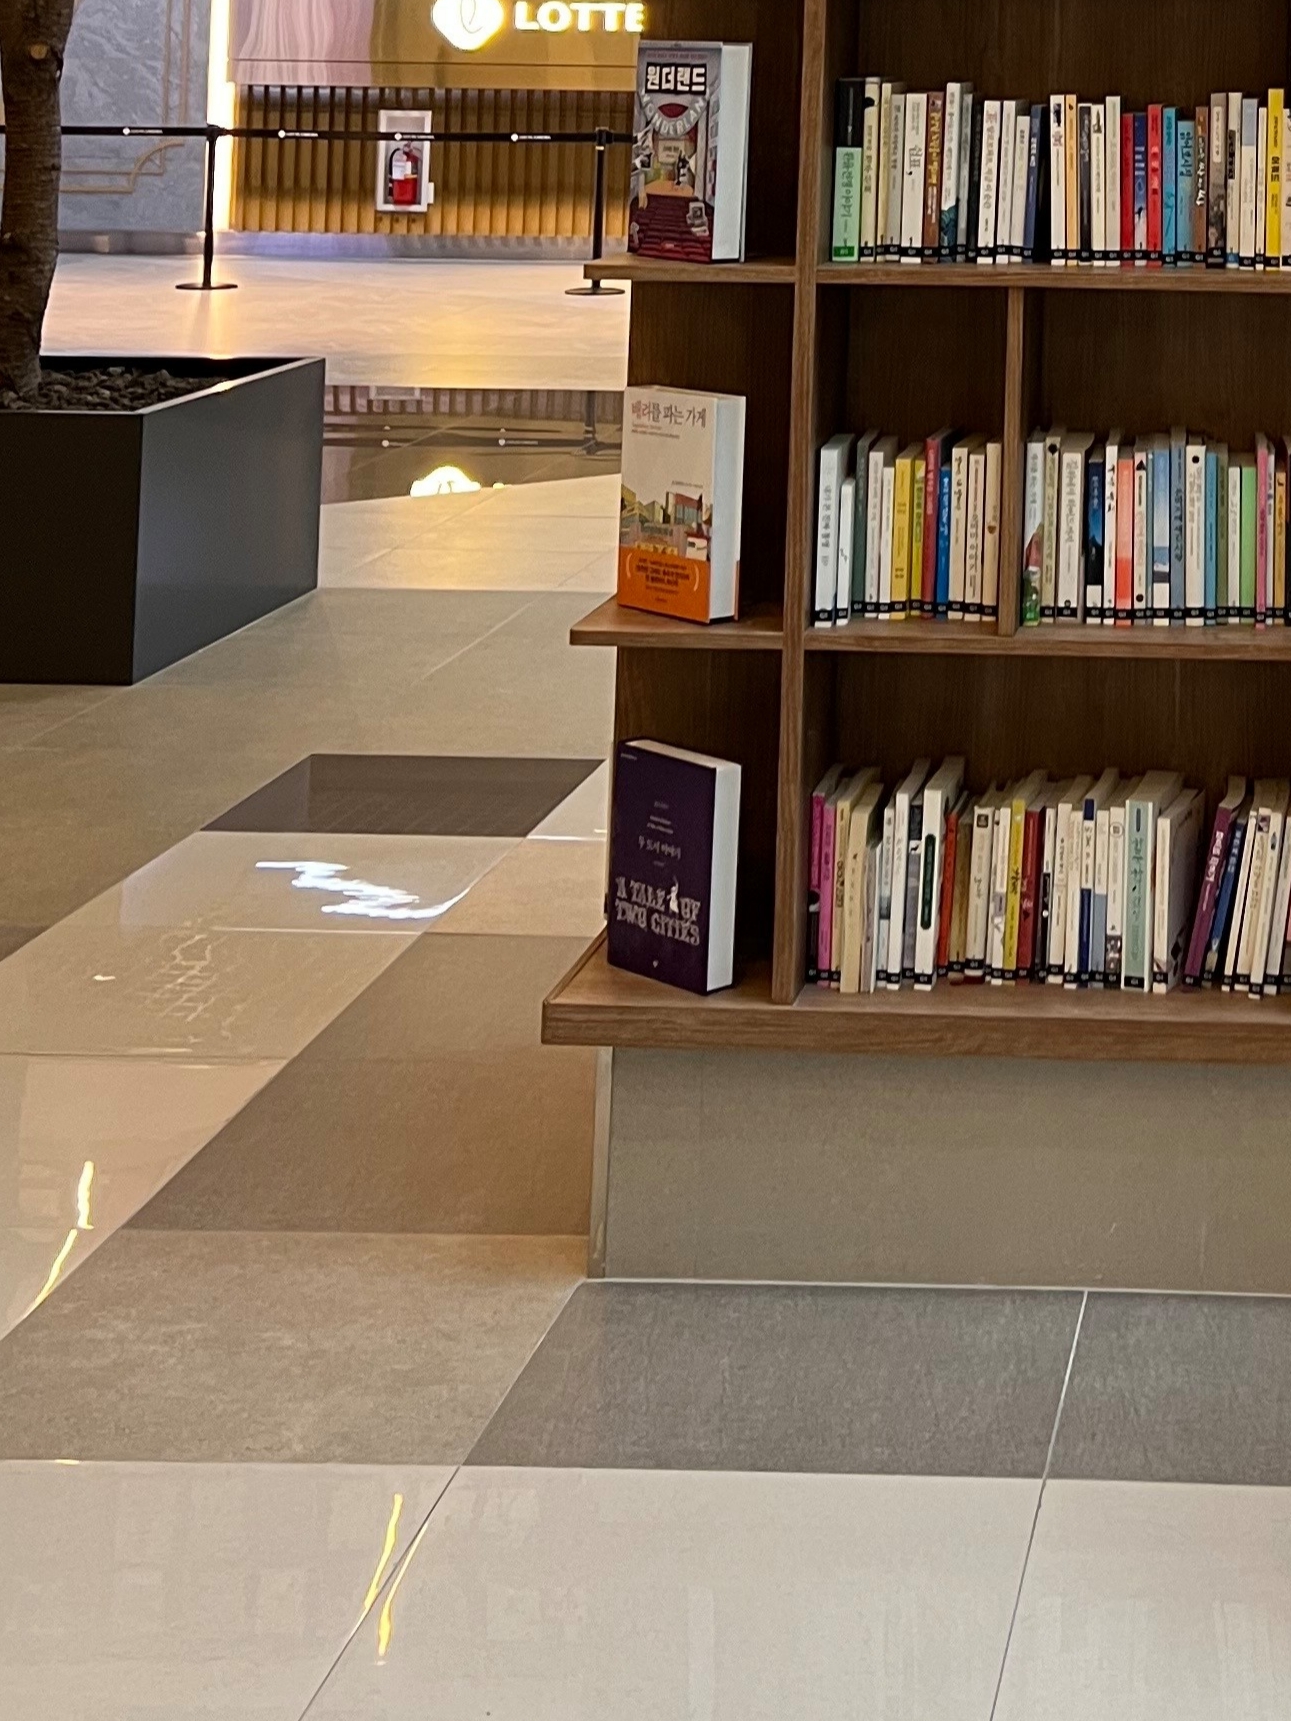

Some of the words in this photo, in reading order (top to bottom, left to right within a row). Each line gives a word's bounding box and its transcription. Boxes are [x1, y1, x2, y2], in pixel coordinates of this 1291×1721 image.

[513, 0, 645, 34] LOTTE
[646, 64, 706, 92] 원더랜드
[663, 403, 684, 426] 파는
[686, 406, 707, 428] 가게
[629, 879, 666, 912] TALE
[680, 897, 701, 922] OF
[614, 898, 648, 934] TWO
[650, 912, 701, 946] CITIES
